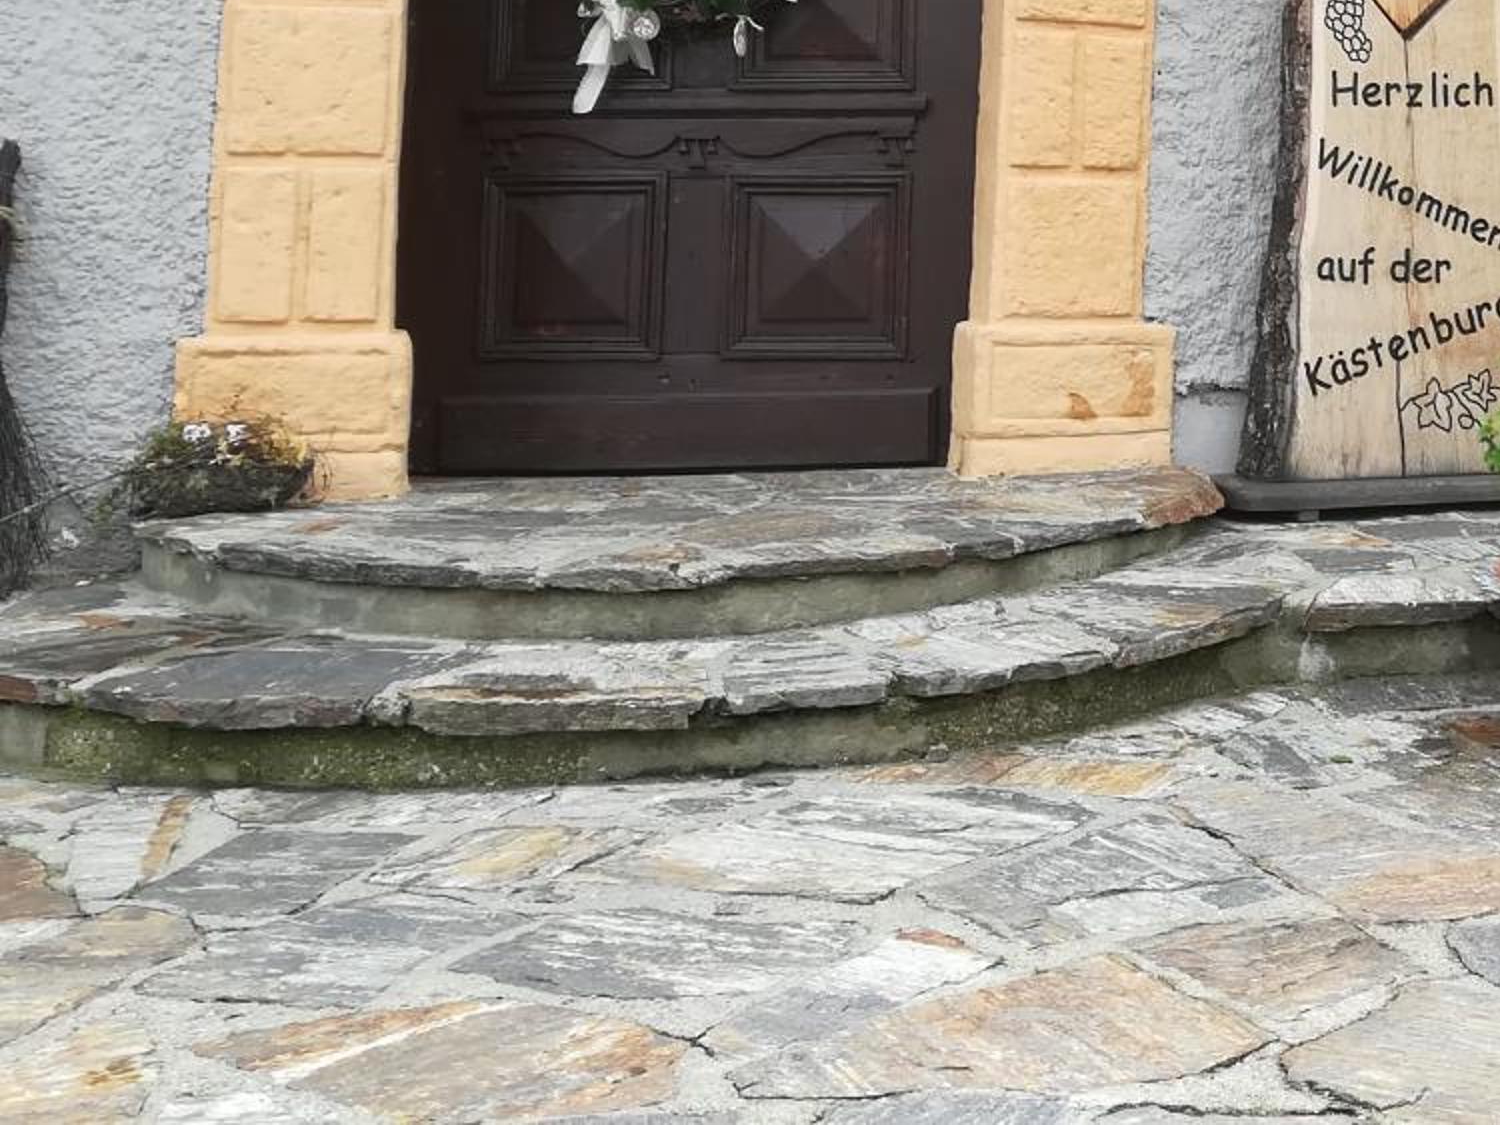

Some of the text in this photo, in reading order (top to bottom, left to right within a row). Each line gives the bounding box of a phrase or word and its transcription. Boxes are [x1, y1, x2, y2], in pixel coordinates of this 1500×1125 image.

[1330, 71, 1494, 109] Herzlich
[1317, 248, 1452, 284] auf der
